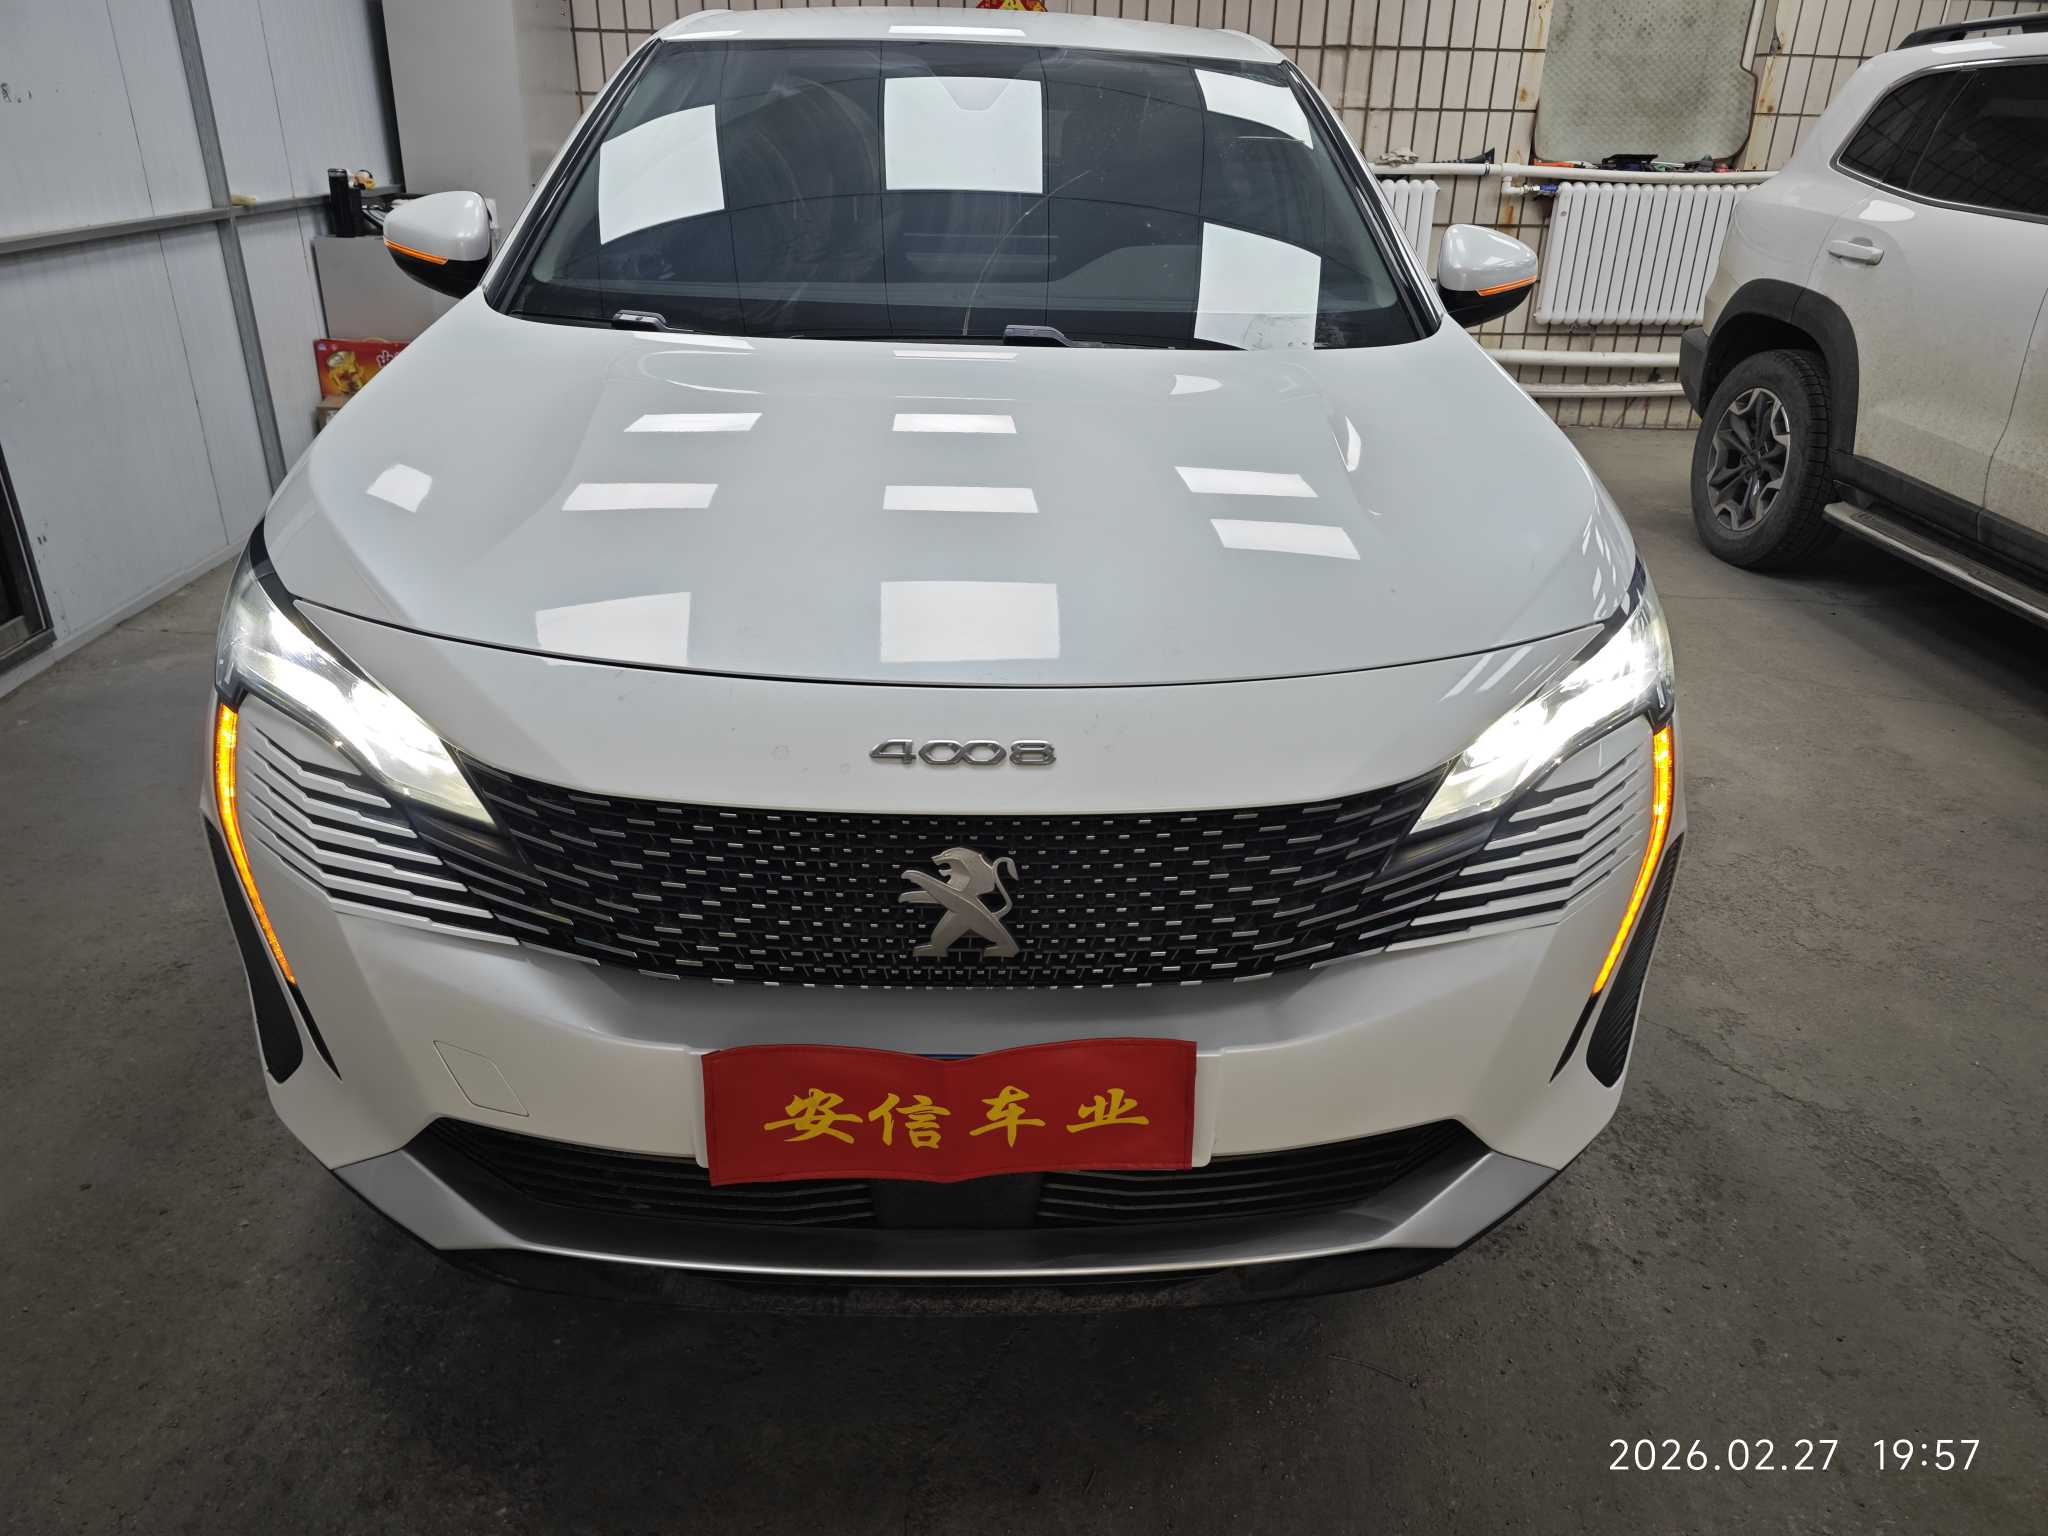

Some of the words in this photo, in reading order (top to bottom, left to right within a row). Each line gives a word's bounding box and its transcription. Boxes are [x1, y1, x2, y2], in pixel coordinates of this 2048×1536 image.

[869, 739, 1057, 766] 4008
[764, 1086, 1149, 1149] 安信车业
